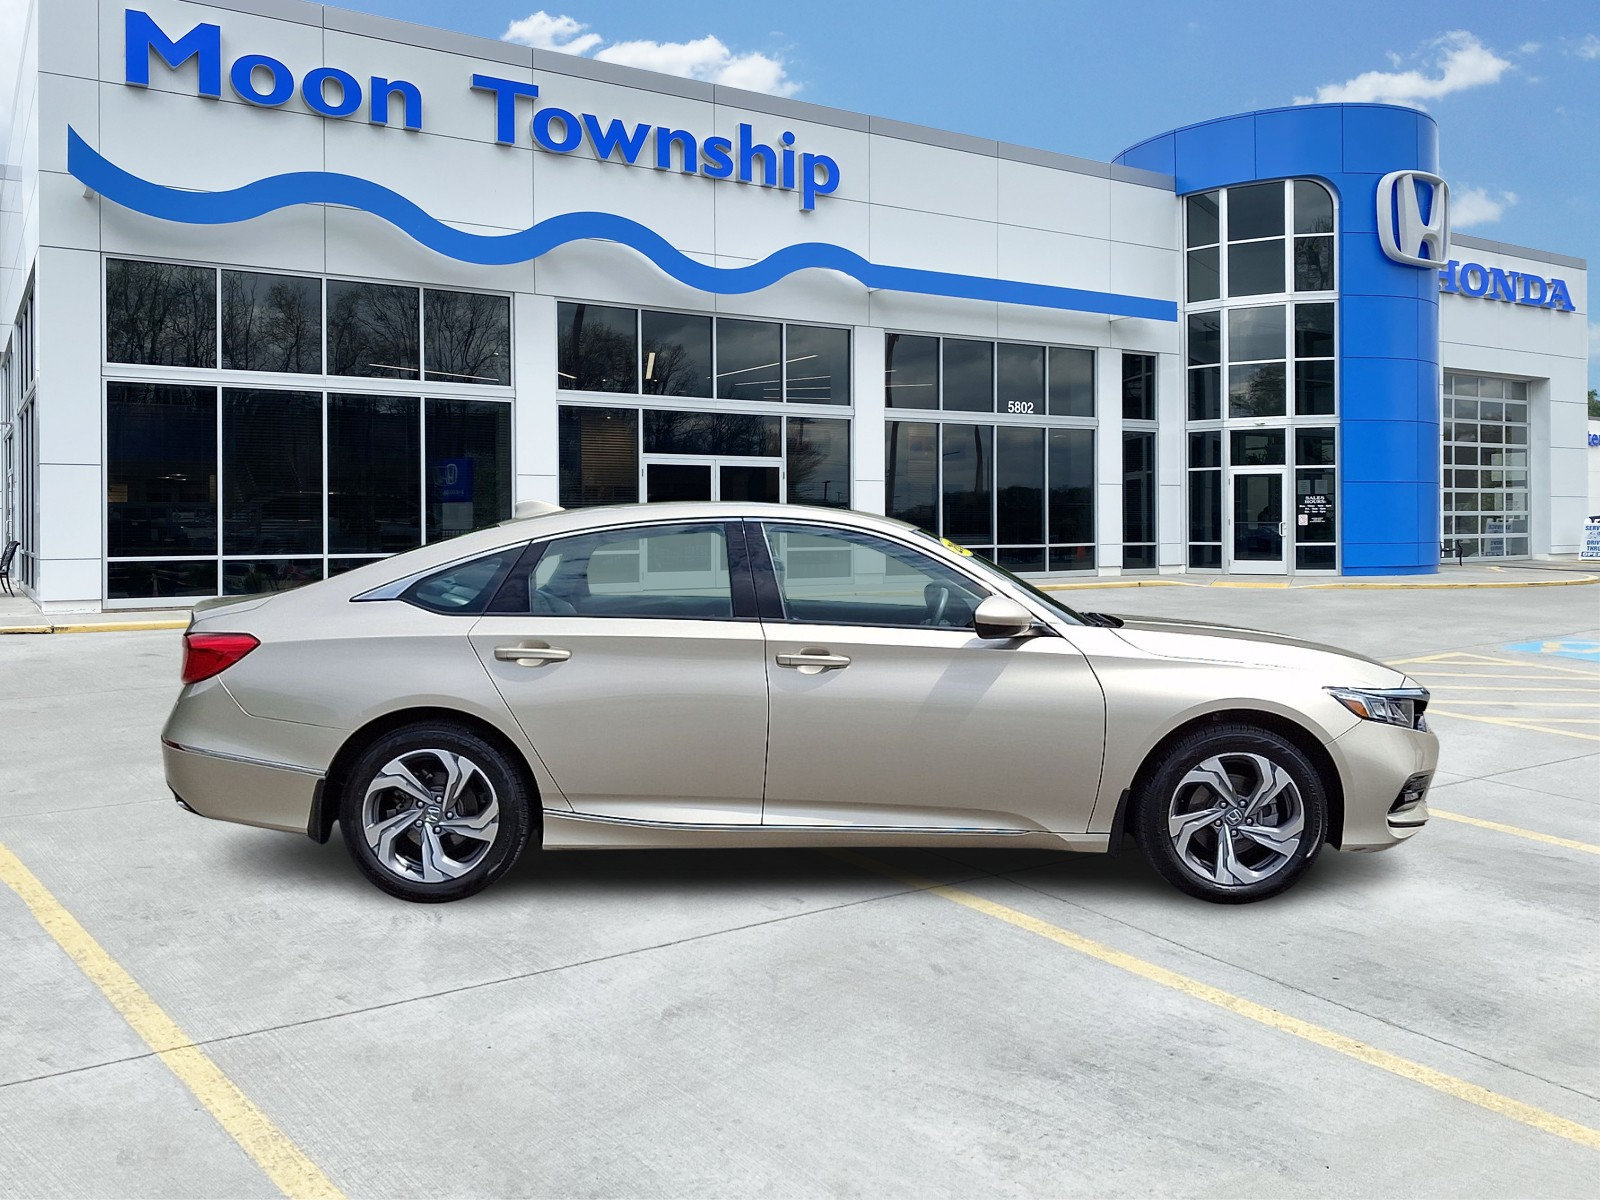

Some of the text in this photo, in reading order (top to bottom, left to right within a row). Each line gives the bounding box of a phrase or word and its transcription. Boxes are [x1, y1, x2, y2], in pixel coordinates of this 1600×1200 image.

[125, 8, 841, 212] Moon Township
[1007, 400, 1034, 414] 5802
